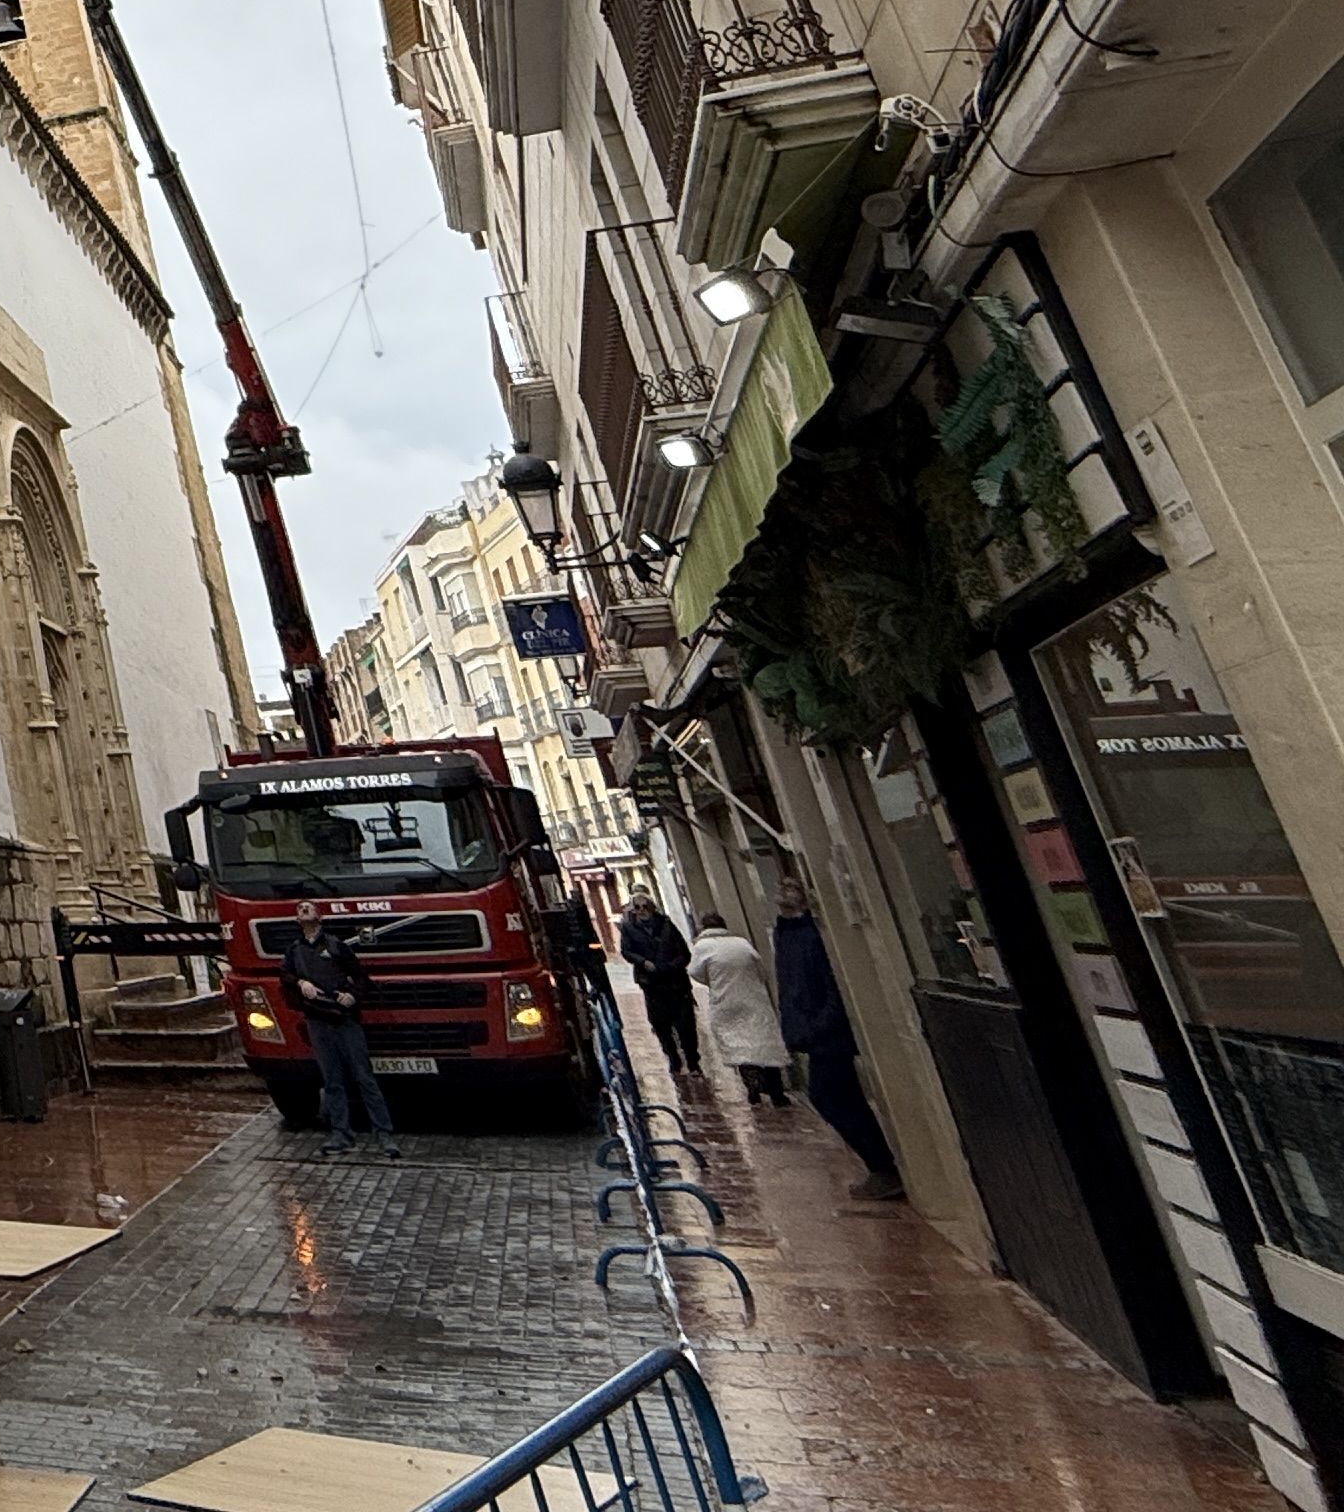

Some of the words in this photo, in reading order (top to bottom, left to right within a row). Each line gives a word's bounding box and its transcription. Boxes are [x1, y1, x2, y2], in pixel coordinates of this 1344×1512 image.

[280, 776, 345, 794] ALAMOS
[347, 772, 412, 789] TORRES
[330, 902, 350, 914] EL
[356, 901, 392, 912] KIKI
